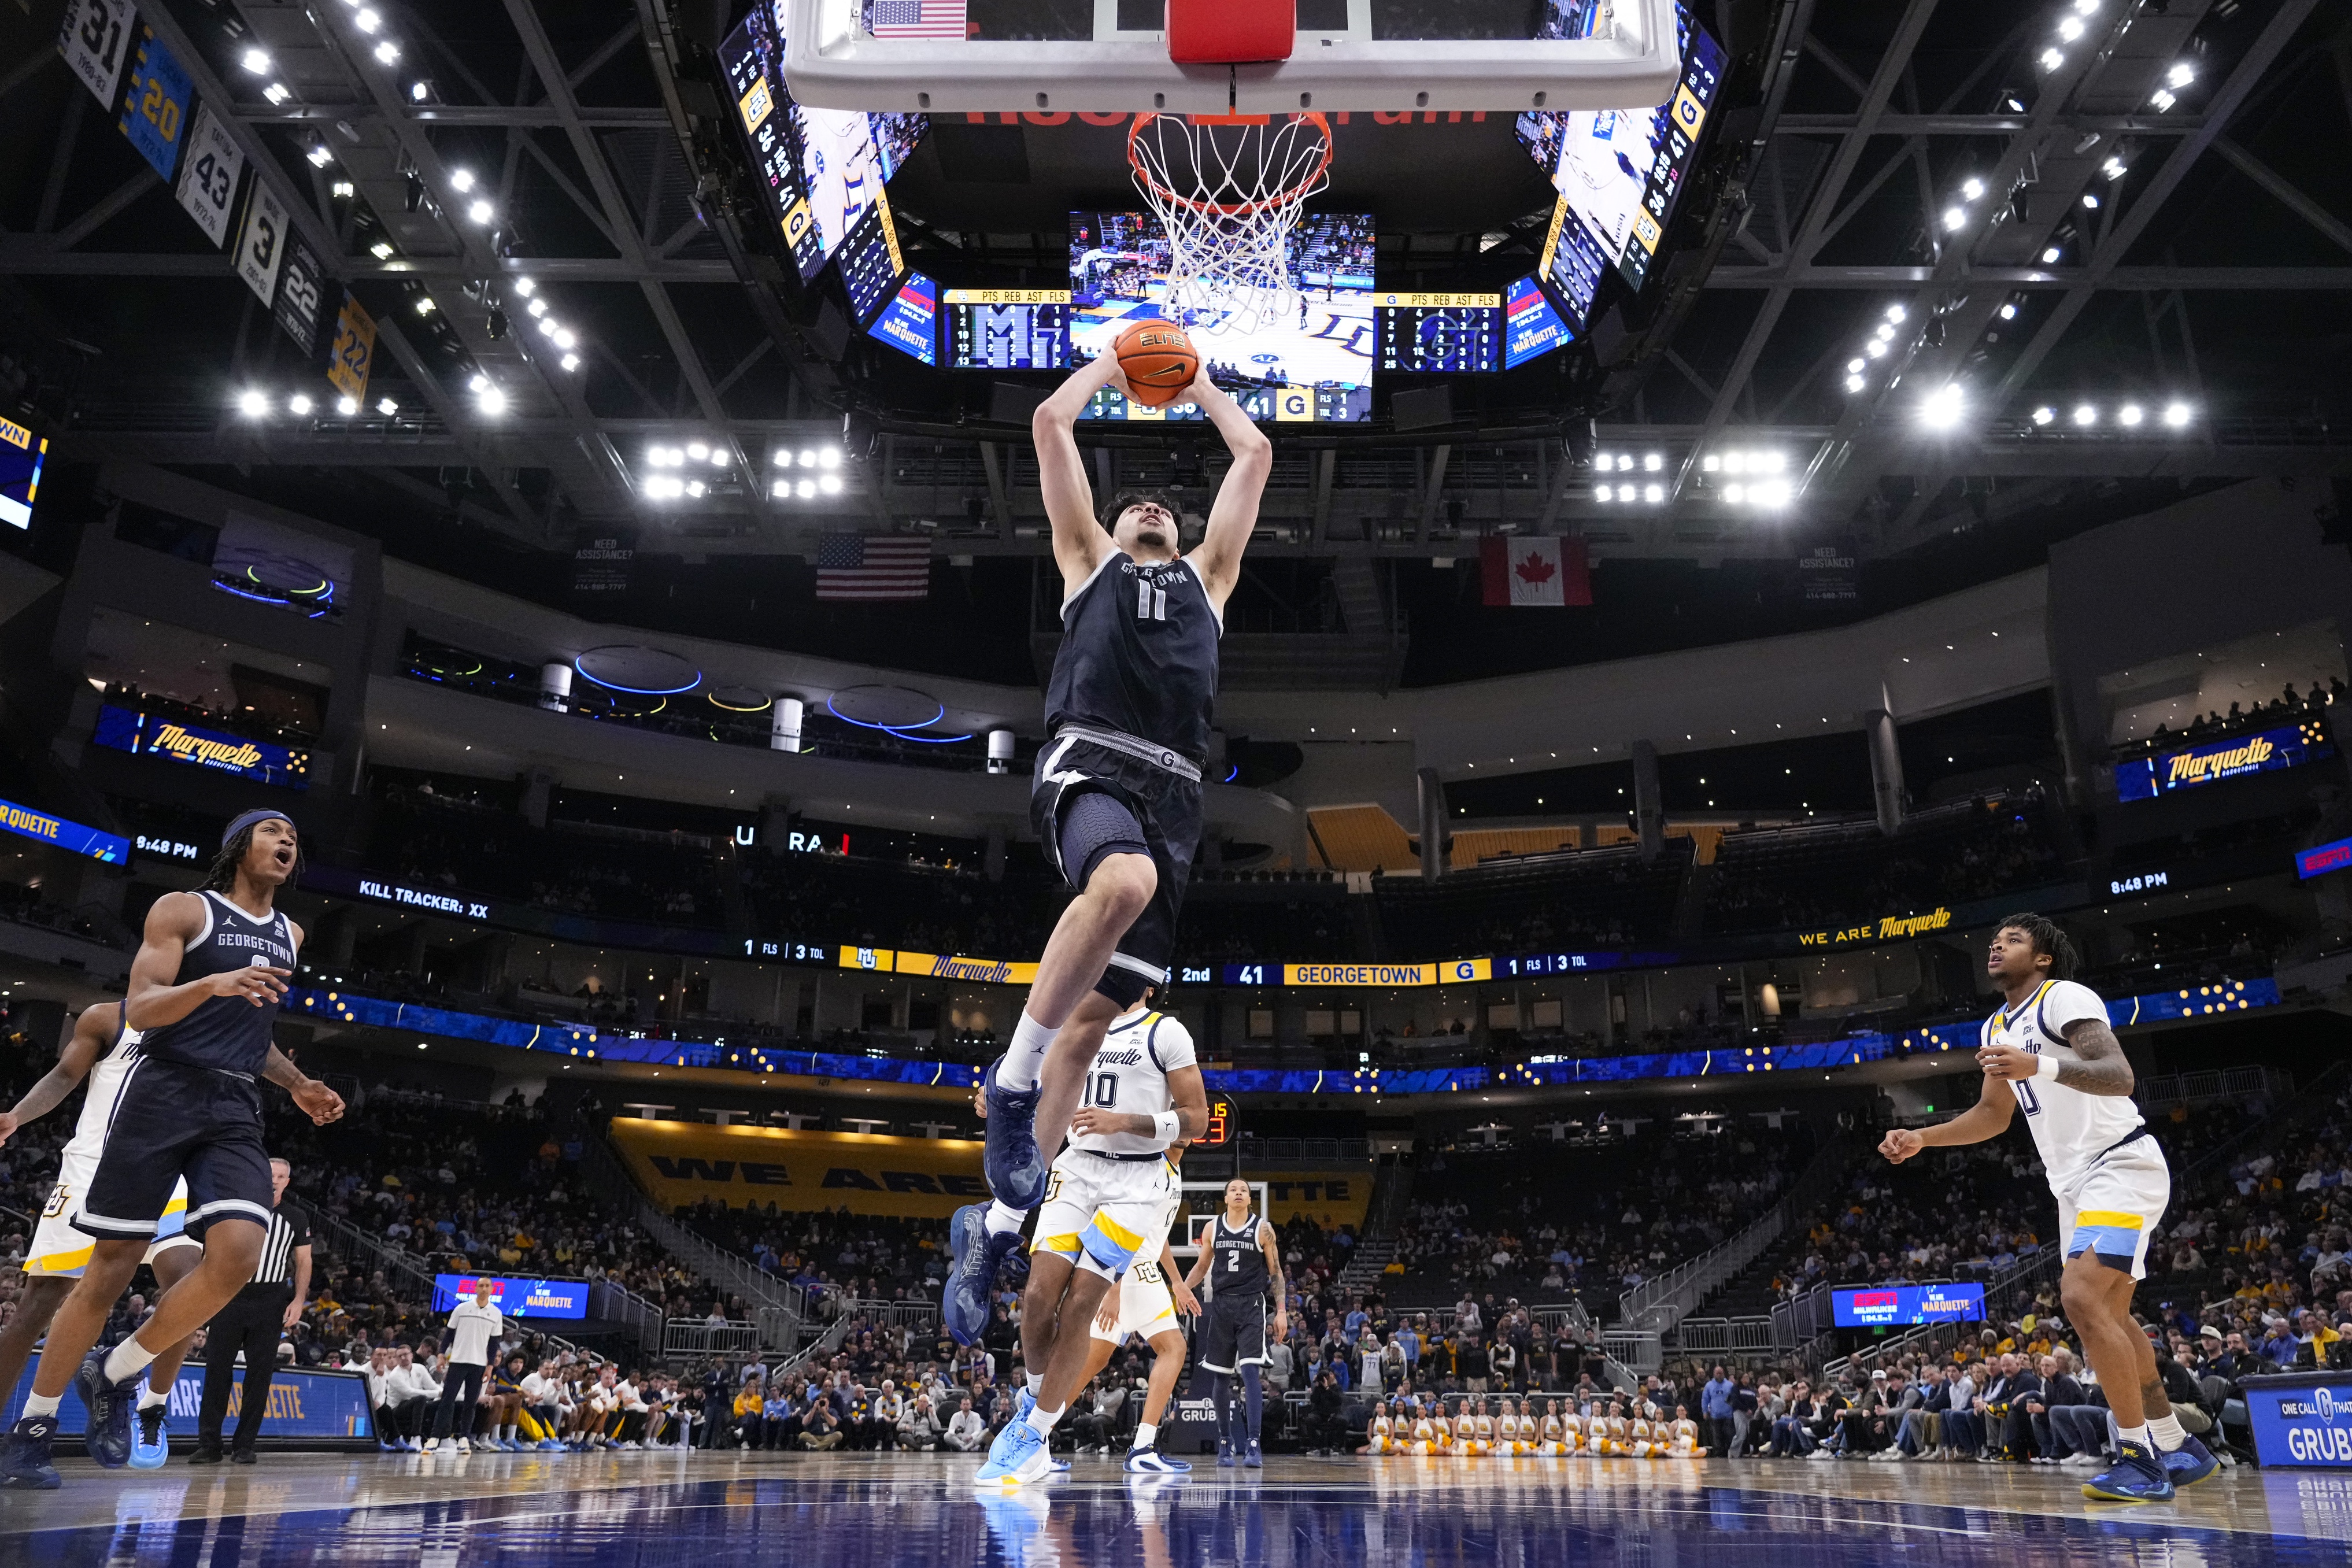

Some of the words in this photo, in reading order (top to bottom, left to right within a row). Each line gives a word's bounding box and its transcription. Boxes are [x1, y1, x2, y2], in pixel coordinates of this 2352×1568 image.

[81, 0, 121, 75] 31
[743, 51, 752, 64] 1
[1694, 57, 1704, 69] 1
[731, 62, 742, 76] 3
[1704, 71, 1715, 84] 3
[142, 77, 180, 143] 20
[1680, 100, 1697, 125] G
[758, 124, 775, 153] 36
[1670, 129, 1687, 160] 41
[196, 153, 230, 211] 43
[779, 185, 796, 210] 41
[1649, 189, 1665, 217] 36
[790, 212, 804, 237] G
[253, 216, 276, 269] 3
[285, 264, 318, 323] 22
[983, 291, 998, 301] PTS
[1005, 291, 1020, 301] REB
[1027, 291, 1043, 301] AST
[1050, 292, 1064, 302] FLS
[1387, 295, 1396, 304] G
[1412, 295, 1428, 305] PTS
[1434, 295, 1450, 305] REB
[1456, 295, 1472, 305] AST
[1479, 296, 1494, 305] FLS
[959, 305, 966, 313] 0
[988, 305, 994, 313] 6
[1009, 305, 1016, 313] 0
[1032, 305, 1037, 313] 1
[1055, 305, 1060, 313] 1
[1388, 309, 1395, 317] 0
[1416, 309, 1422, 317] 4
[1438, 309, 1444, 317] 6
[1461, 309, 1466, 317] 1
[1483, 309, 1489, 317] 3
[959, 319, 966, 327] 2
[988, 319, 994, 327] 2
[1010, 319, 1016, 327] 1
[1032, 319, 1038, 327] 2
[1054, 319, 1061, 327] 0
[1388, 321, 1395, 330] 2
[1416, 321, 1422, 330] 7
[1438, 321, 1444, 330] 3
[1460, 321, 1467, 330] 3
[1482, 321, 1489, 330] 0
[883, 320, 928, 350] MARQUETTE
[957, 331, 970, 339] 10
[988, 331, 994, 339] 3
[1009, 331, 1016, 339] 0
[1032, 331, 1037, 339] 1
[1055, 331, 1060, 339] 1
[1388, 334, 1394, 343] 7
[1415, 334, 1422, 343] 2
[1438, 334, 1444, 343] 2
[1460, 334, 1465, 343] 1
[1482, 334, 1488, 343] 0
[1512, 324, 1559, 354] MARQUETTE
[342, 329, 368, 379] 22
[957, 344, 970, 352] 12
[988, 344, 994, 352] 2
[1009, 344, 1016, 352] 2
[1032, 344, 1038, 352] 0
[1054, 344, 1061, 352] 0
[1385, 347, 1396, 356] 11
[1413, 347, 1424, 356] 15
[1437, 347, 1444, 356] 3
[1460, 347, 1466, 356] 3
[1482, 347, 1487, 356] 1
[957, 357, 970, 365] 13
[988, 357, 994, 365] 5
[1009, 357, 1016, 365] 2
[1032, 357, 1038, 365] 0
[1054, 357, 1061, 365] 2
[1384, 361, 1396, 369] 25
[1415, 361, 1421, 369] 6
[1437, 361, 1443, 369] 4
[1459, 361, 1466, 369] 2
[1481, 361, 1488, 369] 0
[1094, 405, 1103, 416] 3
[1110, 406, 1123, 415] TOL
[1319, 408, 1331, 417] TOL
[1338, 408, 1347, 419] 3
[1096, 391, 1102, 402] 1
[1110, 393, 1122, 401] FLS
[1247, 397, 1269, 415] 41
[1285, 395, 1305, 415] G
[1320, 395, 1332, 403] FLS
[1340, 393, 1347, 404] 1
[0, 420, 24, 444] WN
[595, 539, 616, 549] NEED
[1814, 548, 1836, 557] NEED
[575, 550, 633, 560] ASSISTANCE?
[1800, 557, 1854, 568] ASSISTANCE?
[1137, 578, 1166, 621] 11
[153, 723, 262, 769] Marquette
[1160, 750, 1175, 769] G
[2168, 737, 2273, 781] Marquette
[173, 842, 198, 859] PM
[2305, 846, 2351, 871] ESPN
[2111, 876, 2142, 894] 8:48
[2144, 871, 2168, 888] PM
[359, 881, 392, 899] KILL
[395, 887, 463, 913] TRACKER:
[468, 903, 488, 919] XX
[1799, 933, 1828, 946] WE
[1835, 926, 1872, 942] ARE
[1879, 907, 1951, 939] Marquette
[218, 933, 291, 964] GEORGETOWN
[745, 940, 753, 955] 1
[763, 943, 778, 955] FLS
[796, 945, 805, 959] 3
[810, 948, 824, 960] TOL
[857, 947, 877, 970] MU
[930, 955, 1012, 983] Marquette
[1182, 967, 1210, 982] 2nd
[1239, 966, 1263, 984] 41
[1297, 967, 1421, 983] GEORGETOWN
[1456, 961, 1474, 979] G
[1510, 960, 1517, 974] 1
[1526, 960, 1541, 970] FLS
[1558, 955, 1567, 970] 3
[1571, 955, 1587, 967] TOL
[1084, 1071, 1119, 1108] 10
[650, 1156, 793, 1187] WE
[820, 1168, 994, 1197] ARE
[1216, 1240, 1254, 1251] GEORGETOWN
[1228, 1250, 1240, 1271] 2
[1133, 1261, 1162, 1283] MU
[526, 1295, 573, 1308] MARQUETTE
[1854, 1292, 1898, 1307] ESPN
[1922, 1299, 1970, 1313] MARQUETTE
[1853, 1305, 1898, 1315] MILWAUKEE
[2282, 1403, 2298, 1415] ONE
[2298, 1402, 2317, 1414] CALL
